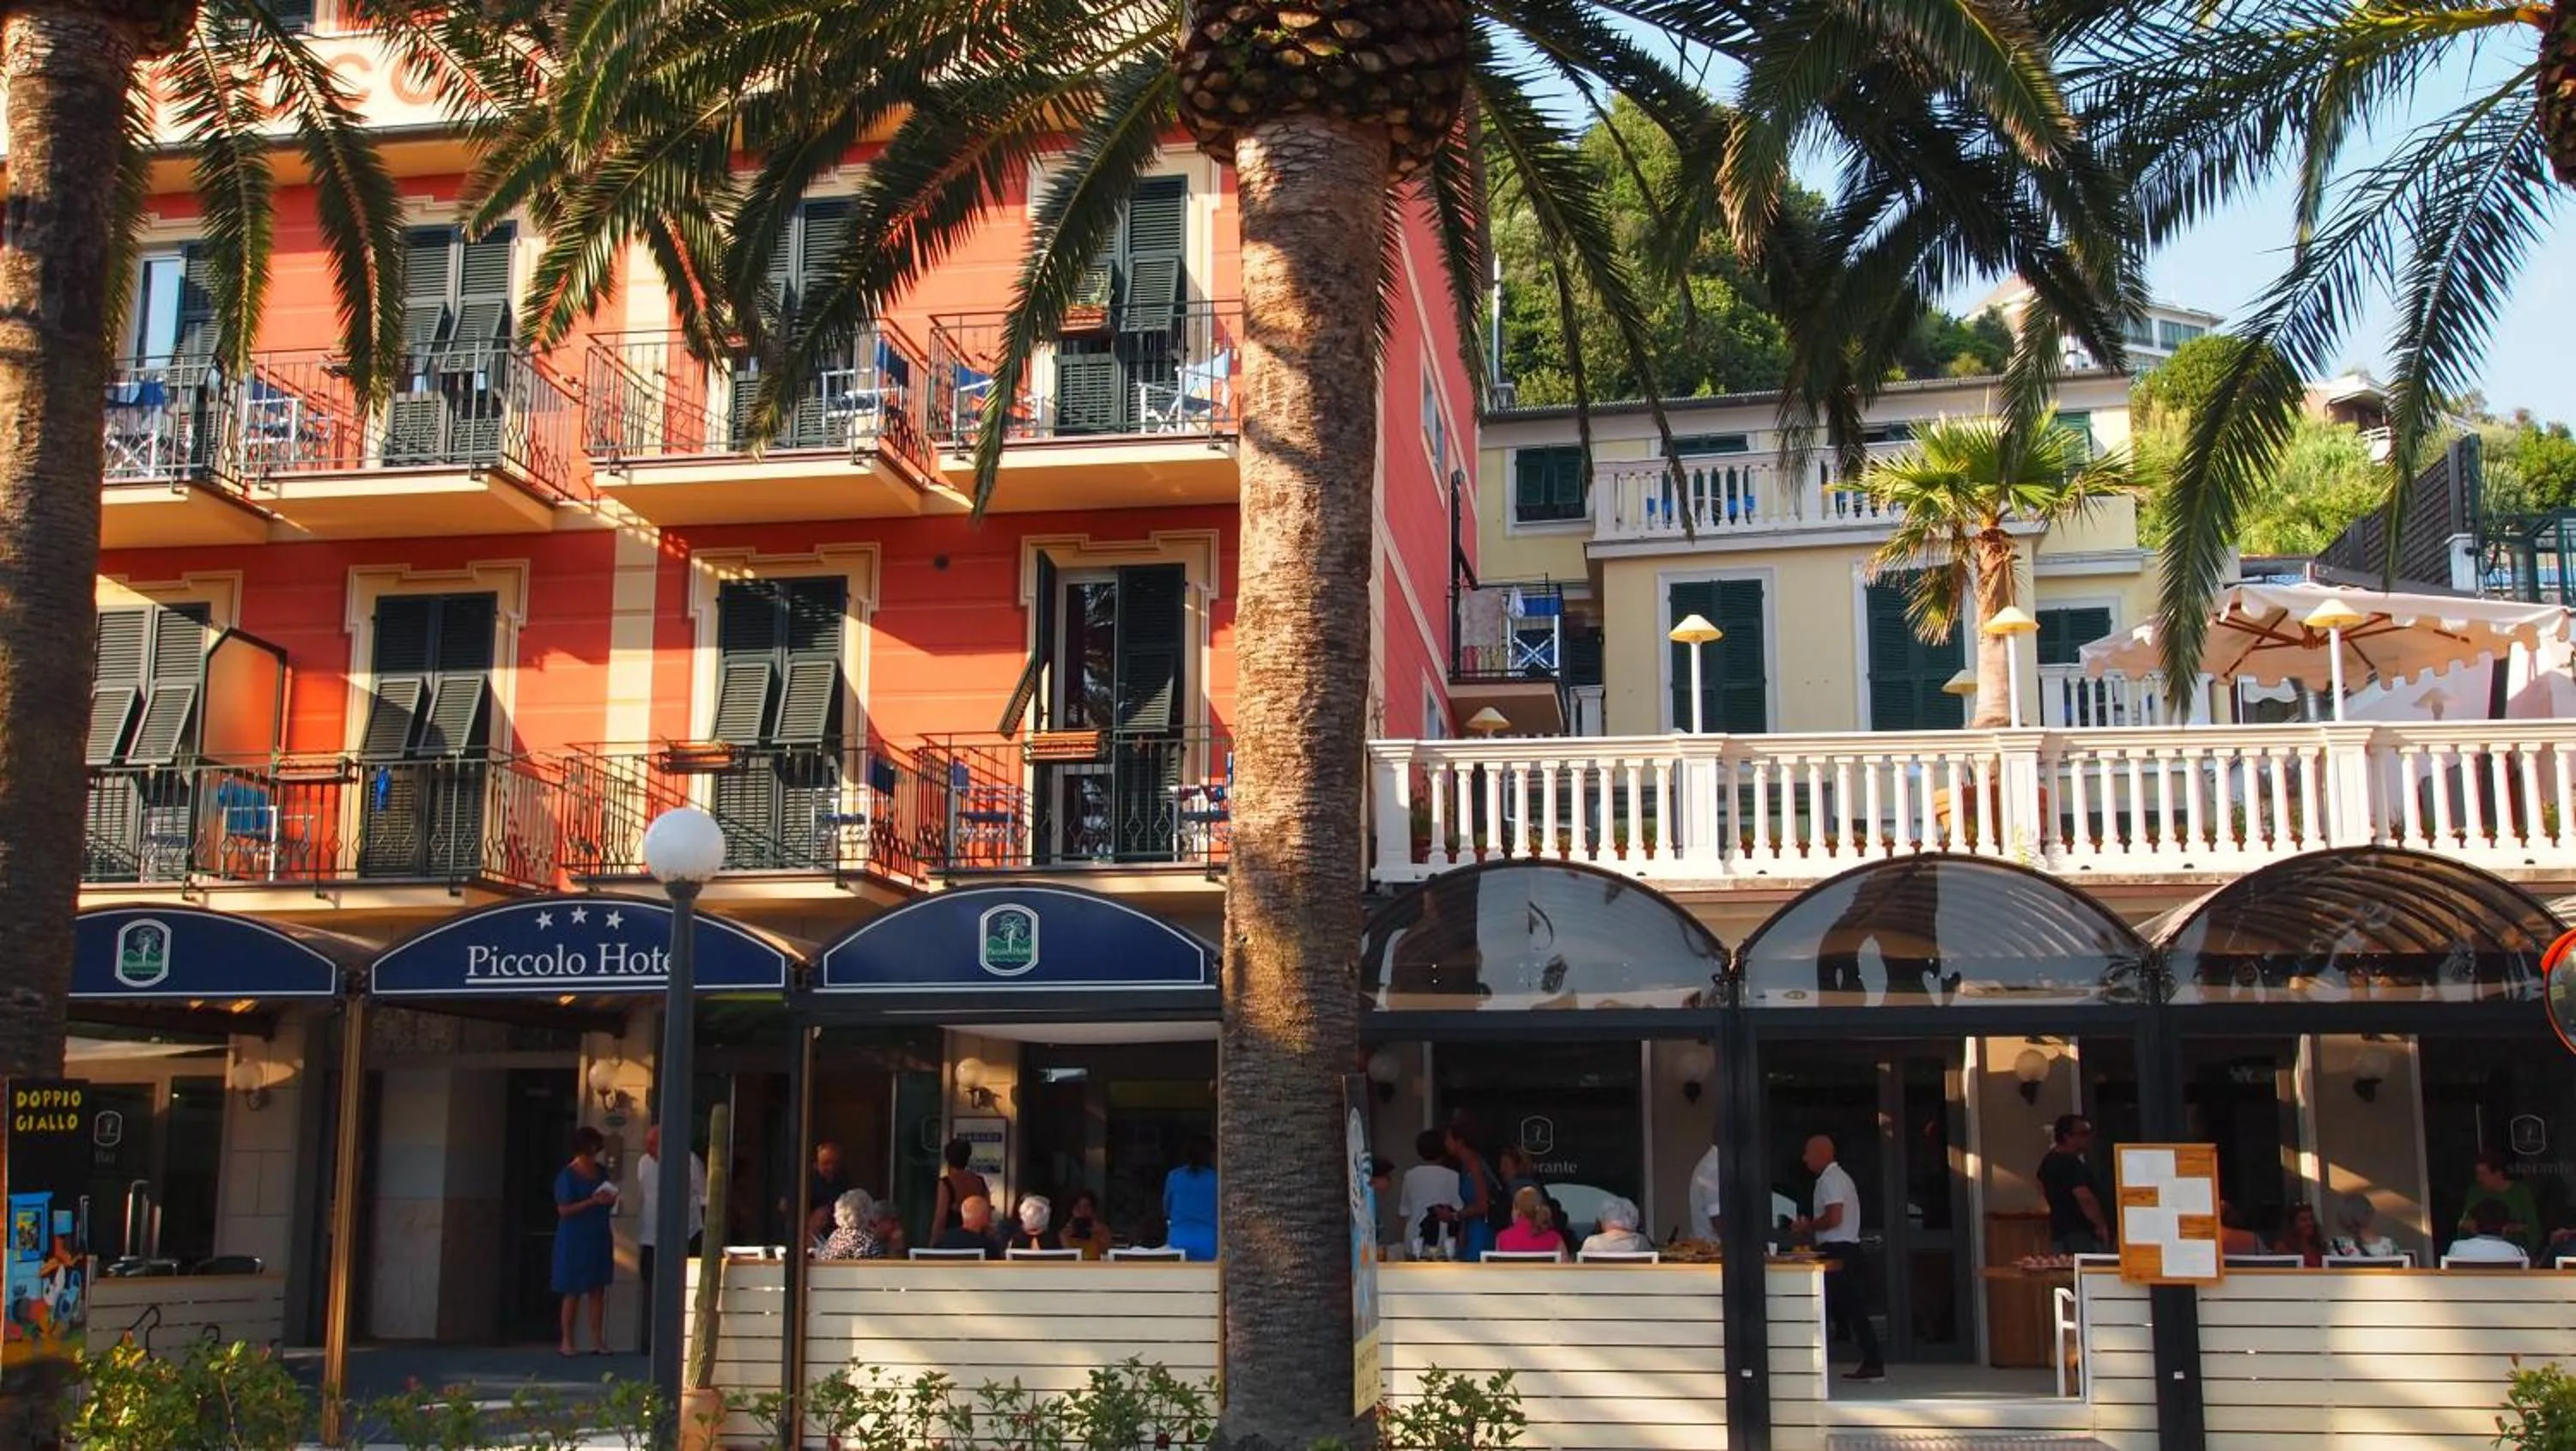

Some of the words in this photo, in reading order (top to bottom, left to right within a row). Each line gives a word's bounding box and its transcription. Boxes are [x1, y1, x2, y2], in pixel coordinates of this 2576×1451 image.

[466, 944, 586, 976] Piccolo
[597, 943, 671, 974] Hote
[15, 1090, 82, 1108] DOPPIO
[15, 1114, 79, 1132] GIALLO
